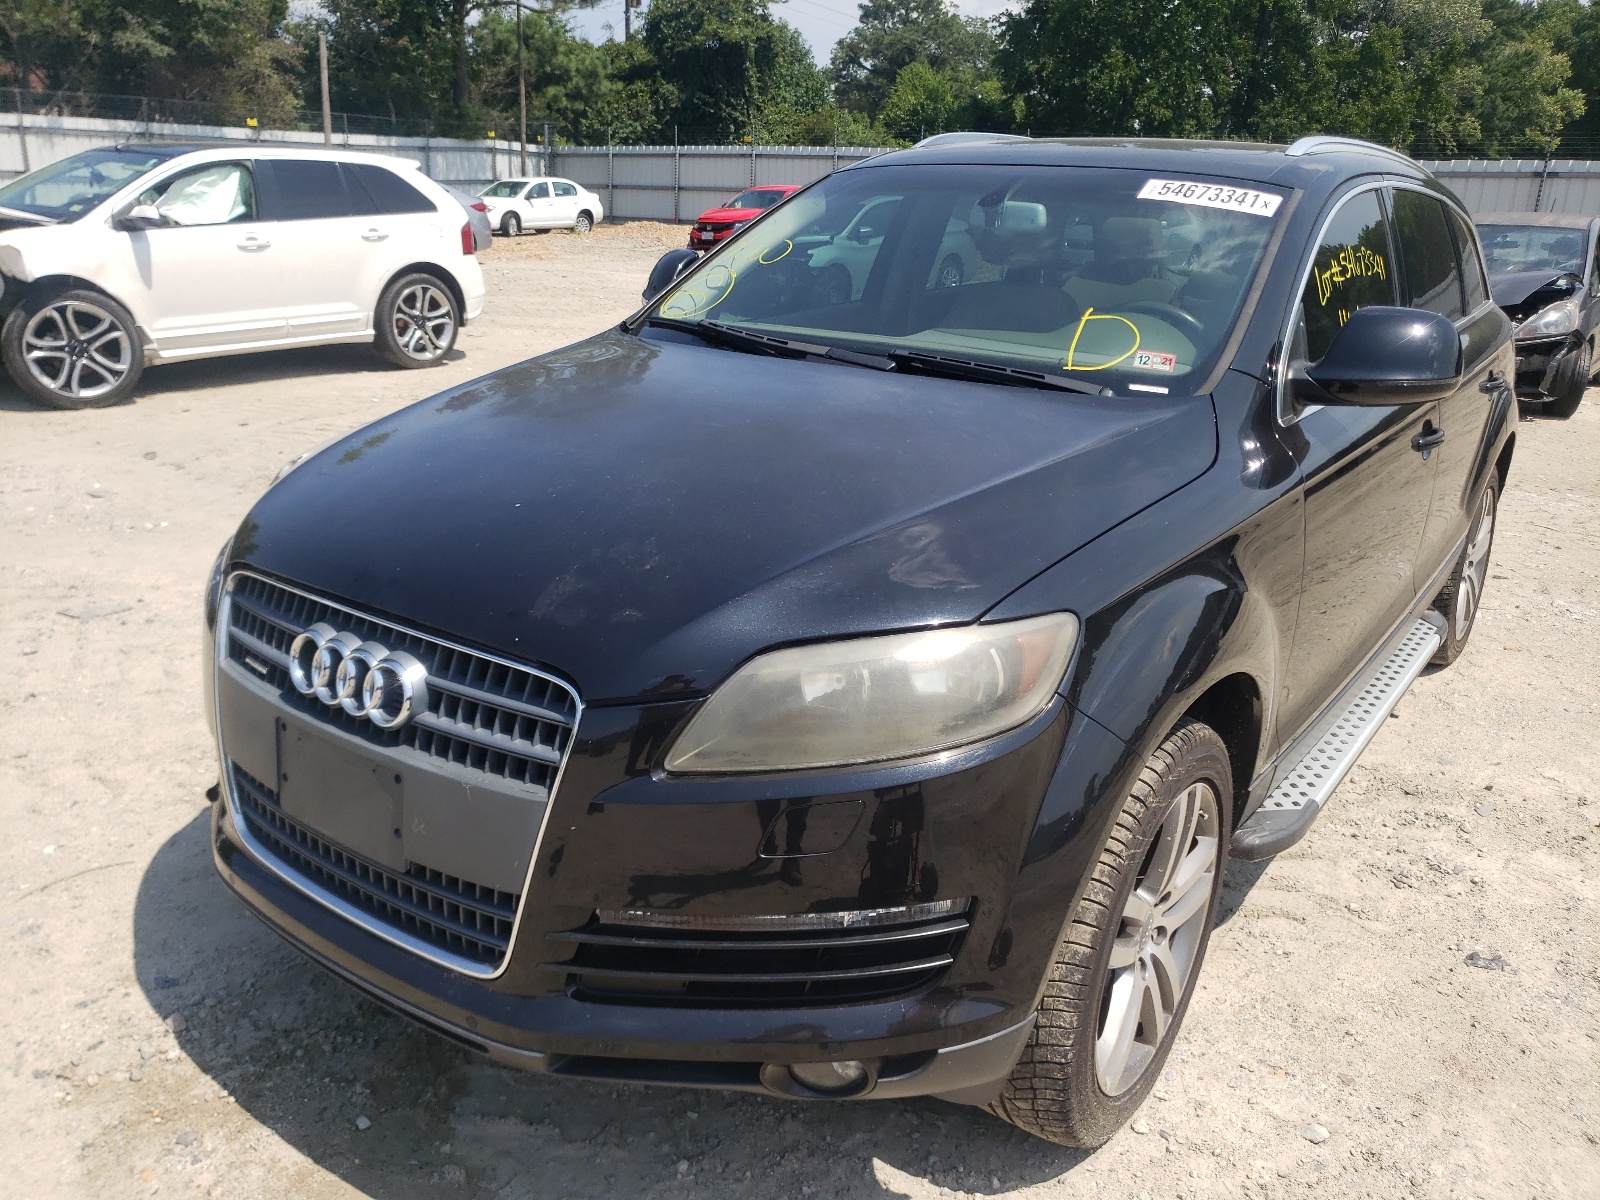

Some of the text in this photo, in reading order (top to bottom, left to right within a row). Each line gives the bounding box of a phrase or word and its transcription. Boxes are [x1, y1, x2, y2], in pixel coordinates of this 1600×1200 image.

[1157, 182, 1261, 208] 54673341
[1137, 354, 1151, 366] 12
[1161, 357, 1173, 366] 21
